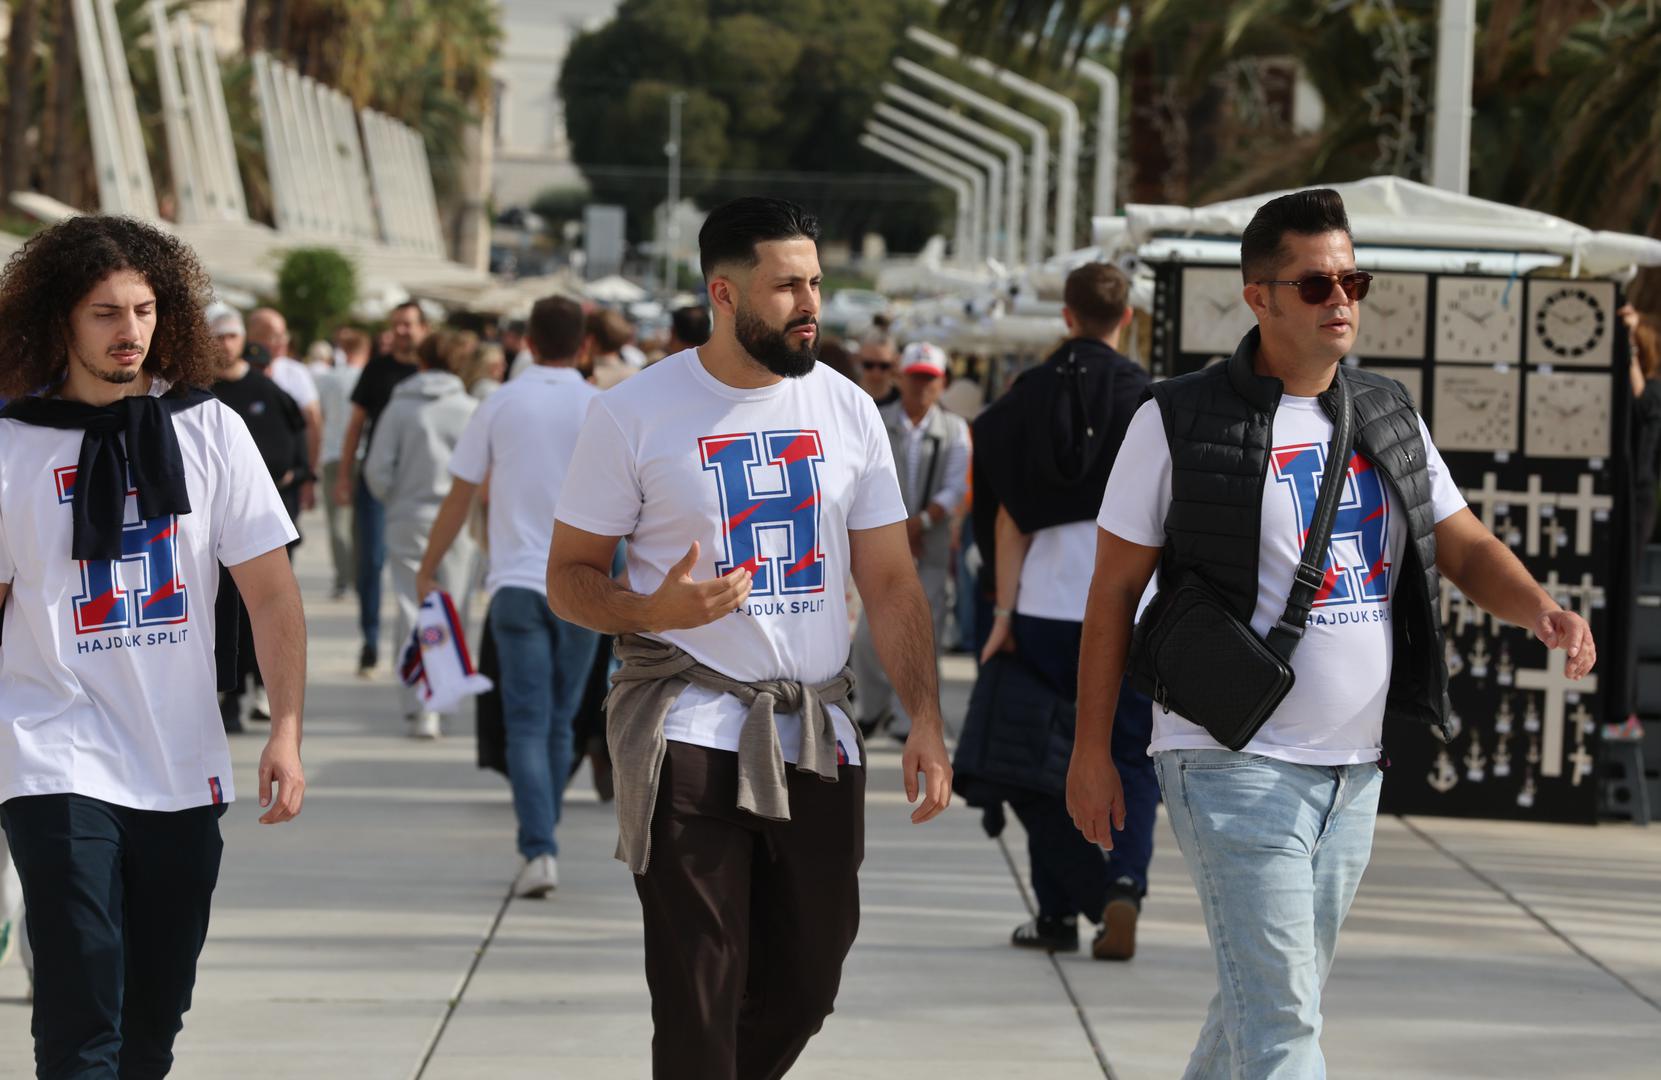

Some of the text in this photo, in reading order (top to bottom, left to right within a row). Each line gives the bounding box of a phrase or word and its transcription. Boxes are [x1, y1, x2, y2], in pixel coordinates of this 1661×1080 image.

[697, 429, 826, 597] H
[1270, 442, 1392, 608] H
[77, 629, 188, 655] HAJDUK SPLIT
[790, 599, 825, 614] SPLIT
